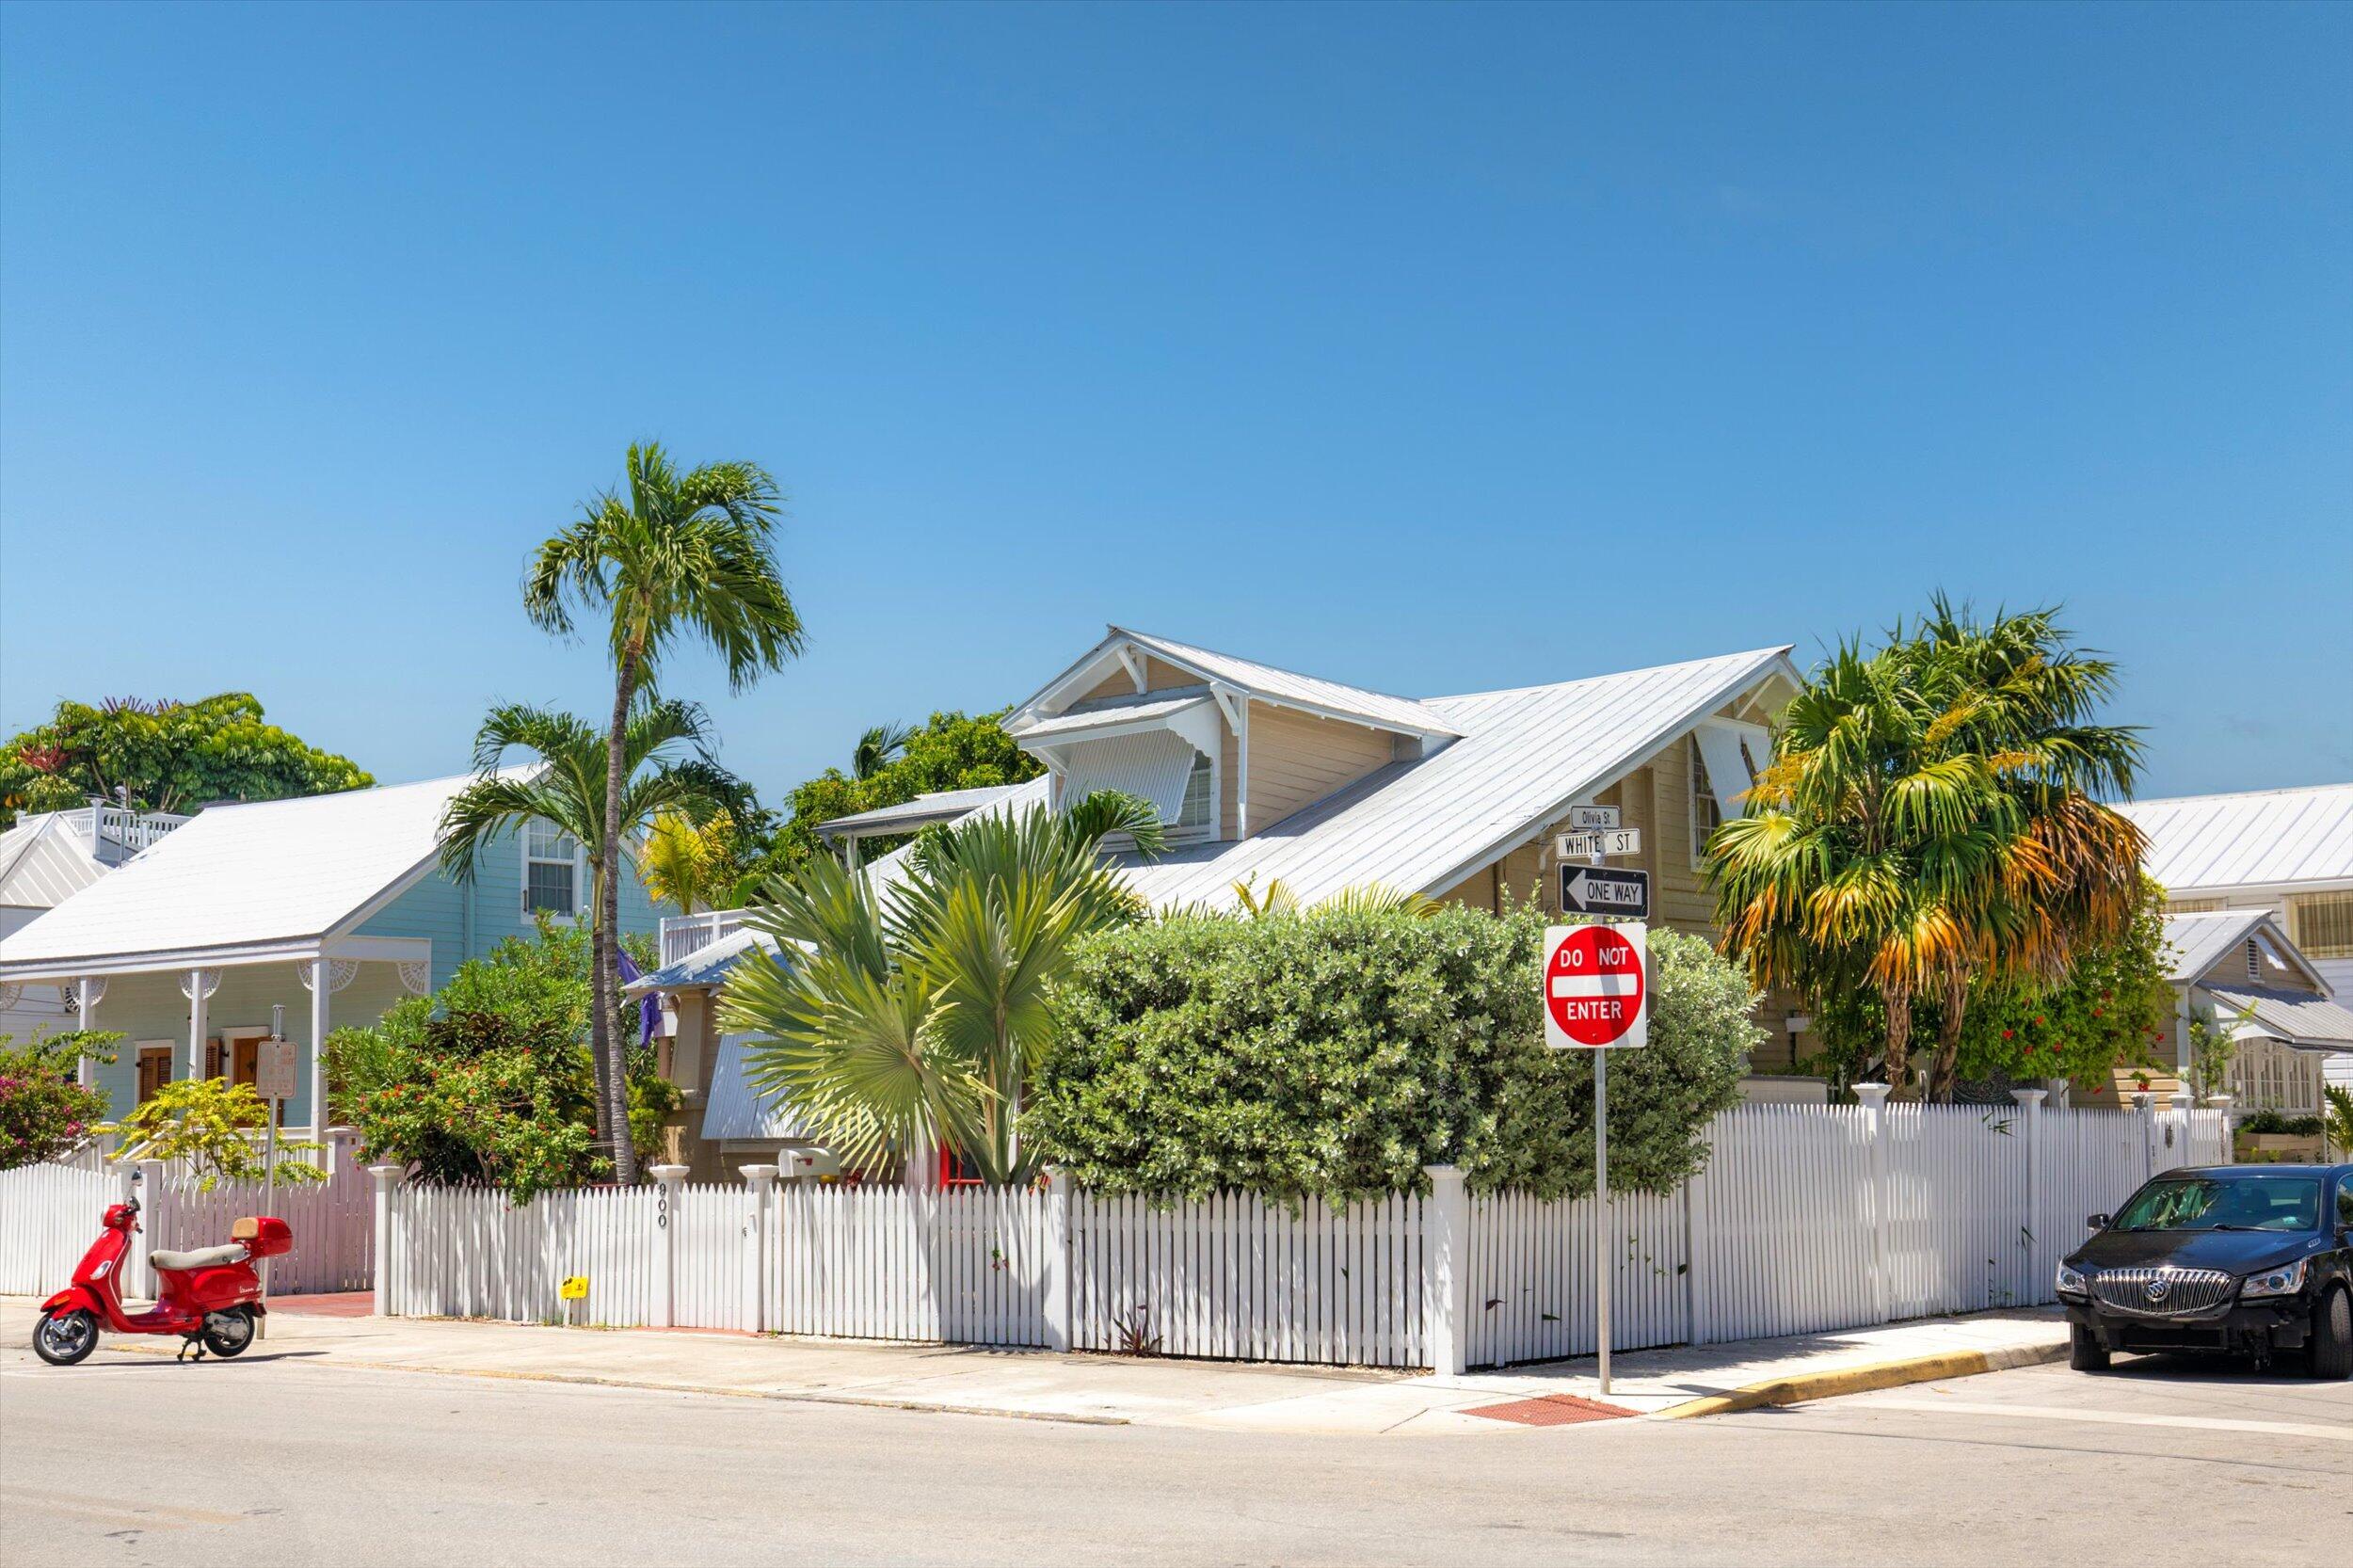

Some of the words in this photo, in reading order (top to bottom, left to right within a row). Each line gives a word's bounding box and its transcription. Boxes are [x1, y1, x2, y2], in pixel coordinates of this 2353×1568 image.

[1582, 811, 1601, 824] Olivia
[1604, 811, 1610, 824] St
[1565, 836, 1601, 855] WHITE
[1617, 834, 1630, 851] ST
[1588, 882, 1609, 901] ONE
[1614, 884, 1639, 903] WAY
[1561, 949, 1583, 968] DO
[1599, 947, 1628, 966] NOT
[1567, 1000, 1622, 1020] ENTER
